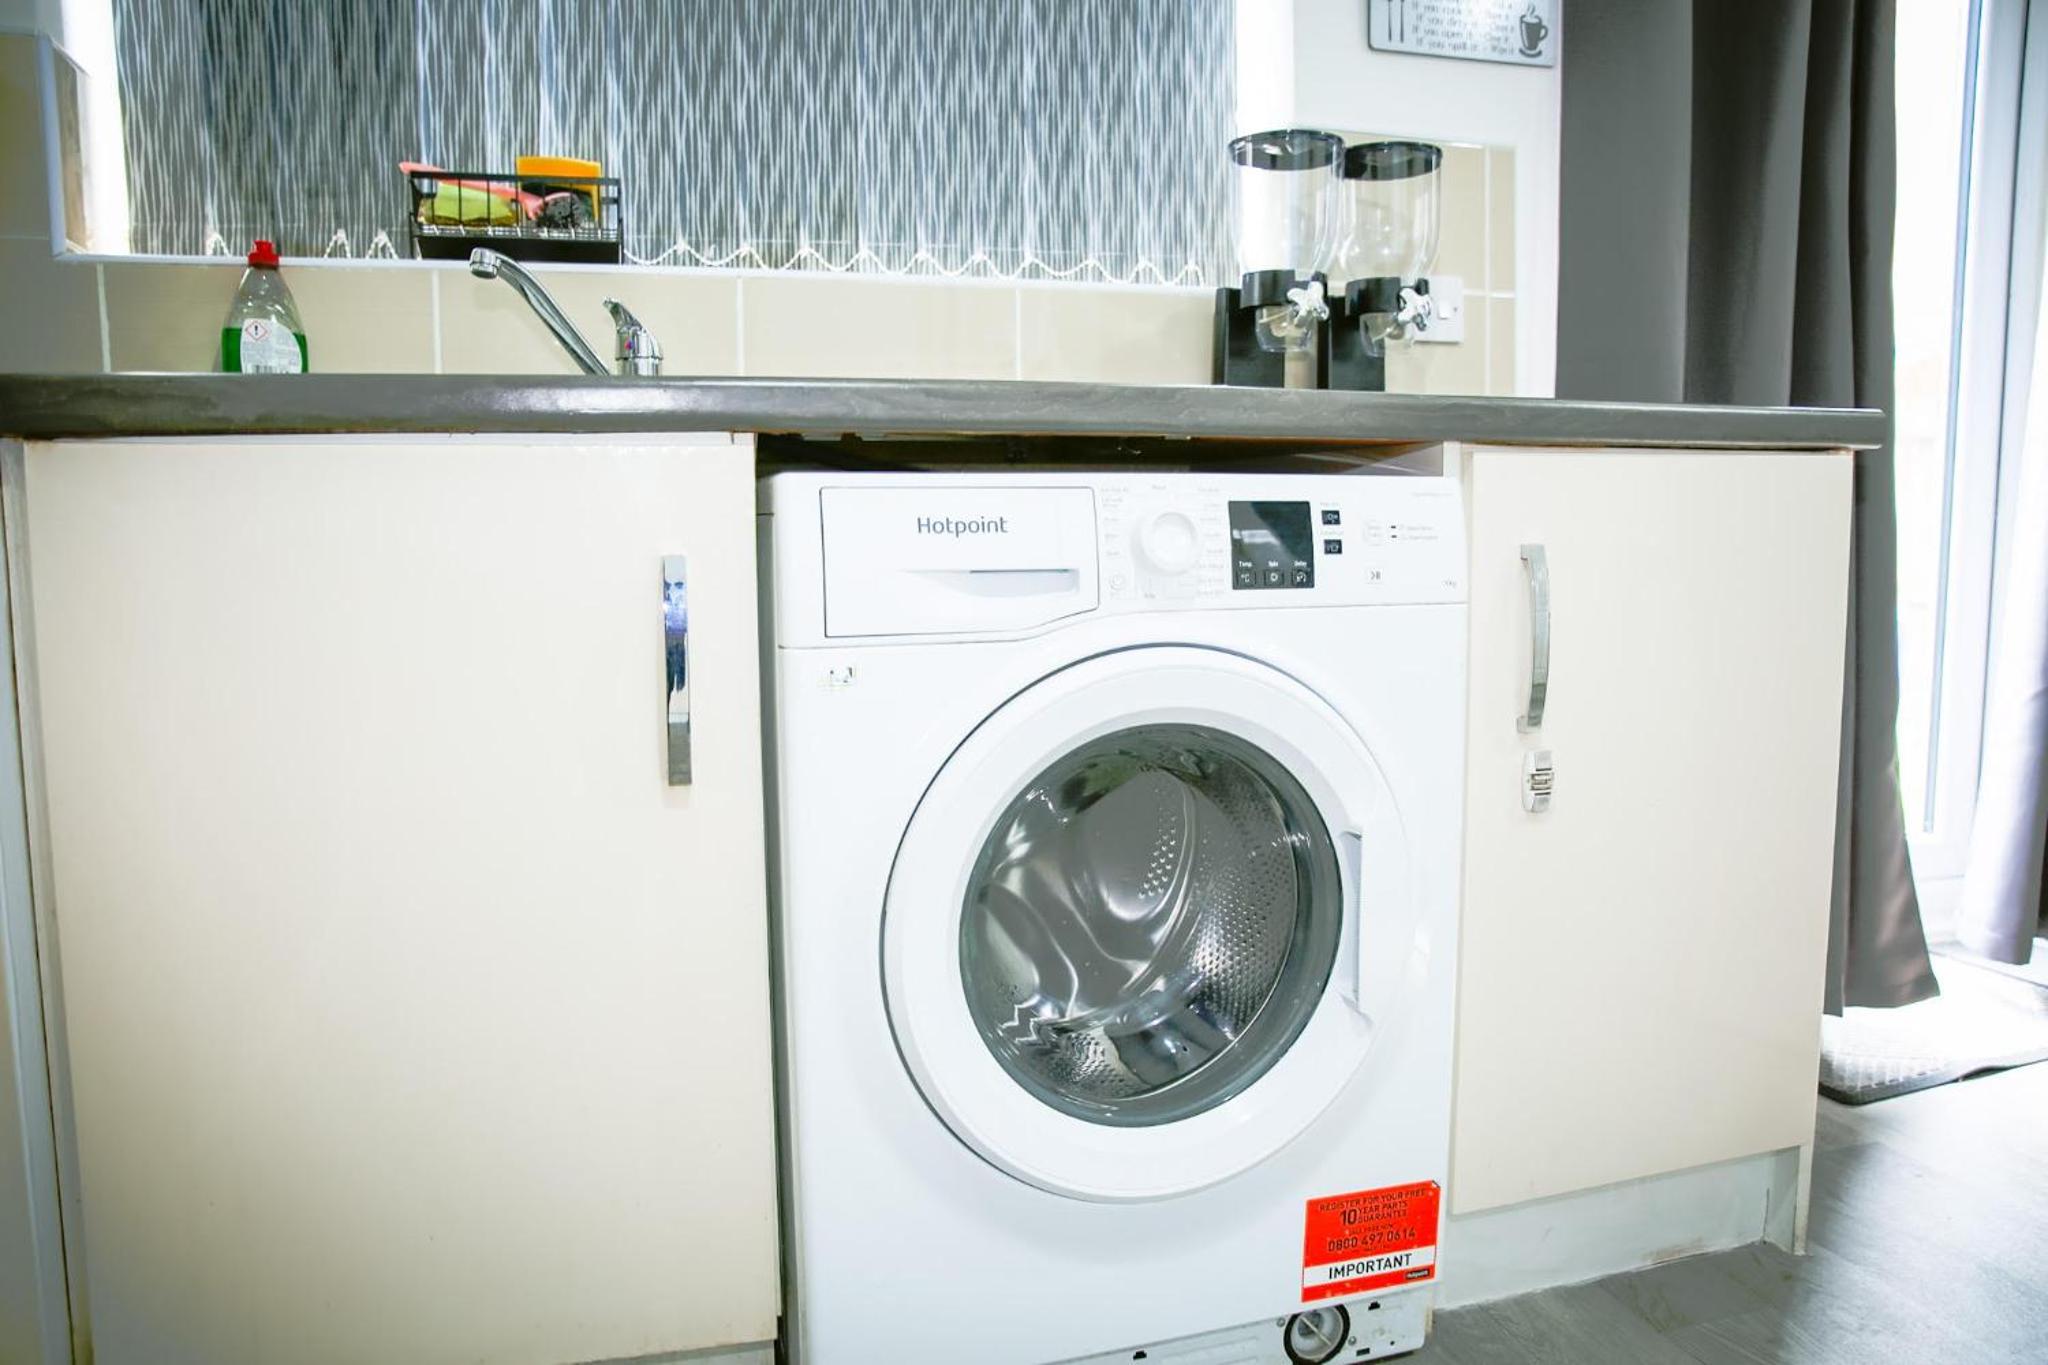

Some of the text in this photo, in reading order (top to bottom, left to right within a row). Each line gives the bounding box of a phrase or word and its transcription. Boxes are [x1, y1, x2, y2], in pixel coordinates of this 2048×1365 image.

[917, 516, 1008, 538] Hotpoint
[1319, 1199, 1361, 1212] REGISTER
[1381, 1191, 1403, 1202] YOUR
[1340, 1200, 1408, 1226] 10 YEAR PARTS
[1328, 1236, 1358, 1252] 0800
[1361, 1231, 1383, 1246] 497
[1328, 1253, 1412, 1280] IMPORTANT
